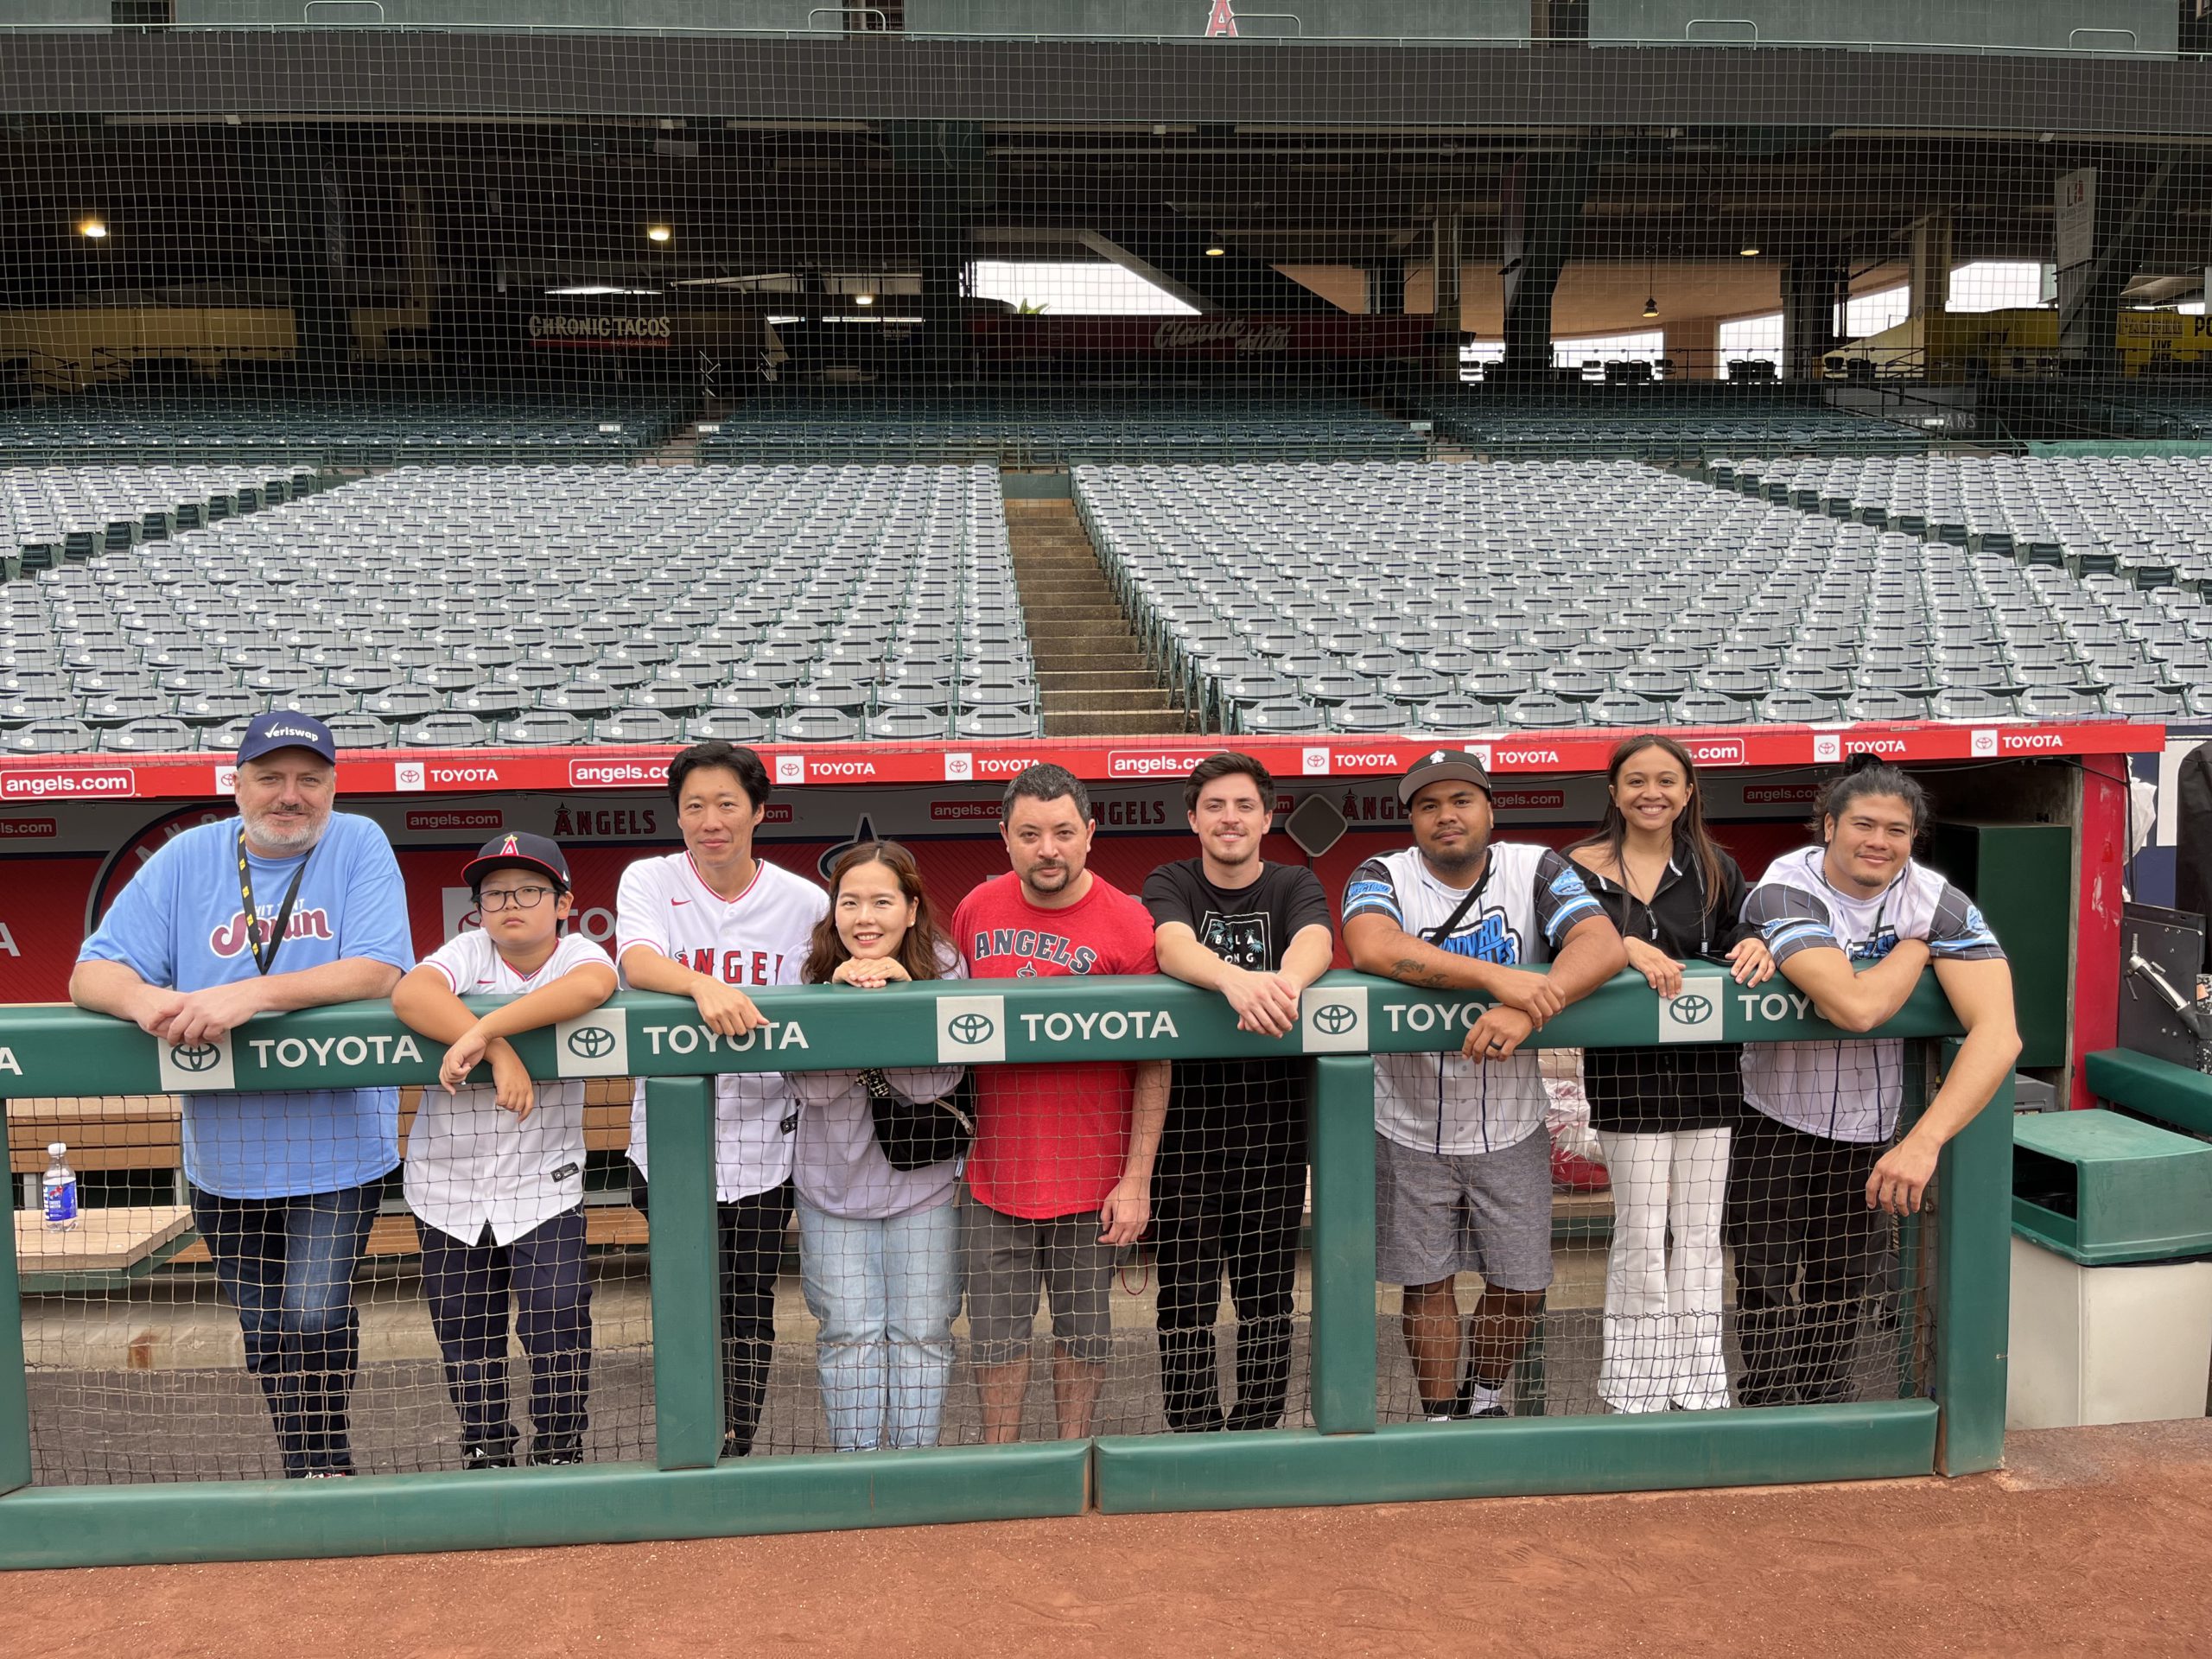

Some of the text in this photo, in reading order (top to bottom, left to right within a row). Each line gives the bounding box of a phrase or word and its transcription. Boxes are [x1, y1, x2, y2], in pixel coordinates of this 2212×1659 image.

[529, 315, 671, 338] CHRONIC TACOS
[1845, 741, 1906, 754] TOYOTA
[2003, 734, 2063, 748] TOYOTA
[1335, 754, 1397, 767] TOYOTA
[1497, 751, 1560, 765] TOYOTA
[430, 768, 499, 783] TOYOTA
[575, 764, 669, 783] angels.co
[810, 762, 876, 776] TOYOTA
[6, 775, 128, 795] angels.com
[933, 804, 1003, 818] angels.co
[1090, 801, 1166, 825] NGELS
[1342, 788, 1409, 821] ANGE
[410, 813, 499, 828] angels.com
[553, 802, 657, 836] ANGELS
[975, 929, 1097, 976] ANGELS
[1214, 951, 1255, 964] ONG
[1383, 1002, 1505, 1033] TOYO
[1738, 994, 1830, 1021] TOY
[1020, 1010, 1179, 1042] TOYOTA
[643, 1021, 810, 1055] TOYOTA
[249, 1035, 423, 1069] TOYOTA
